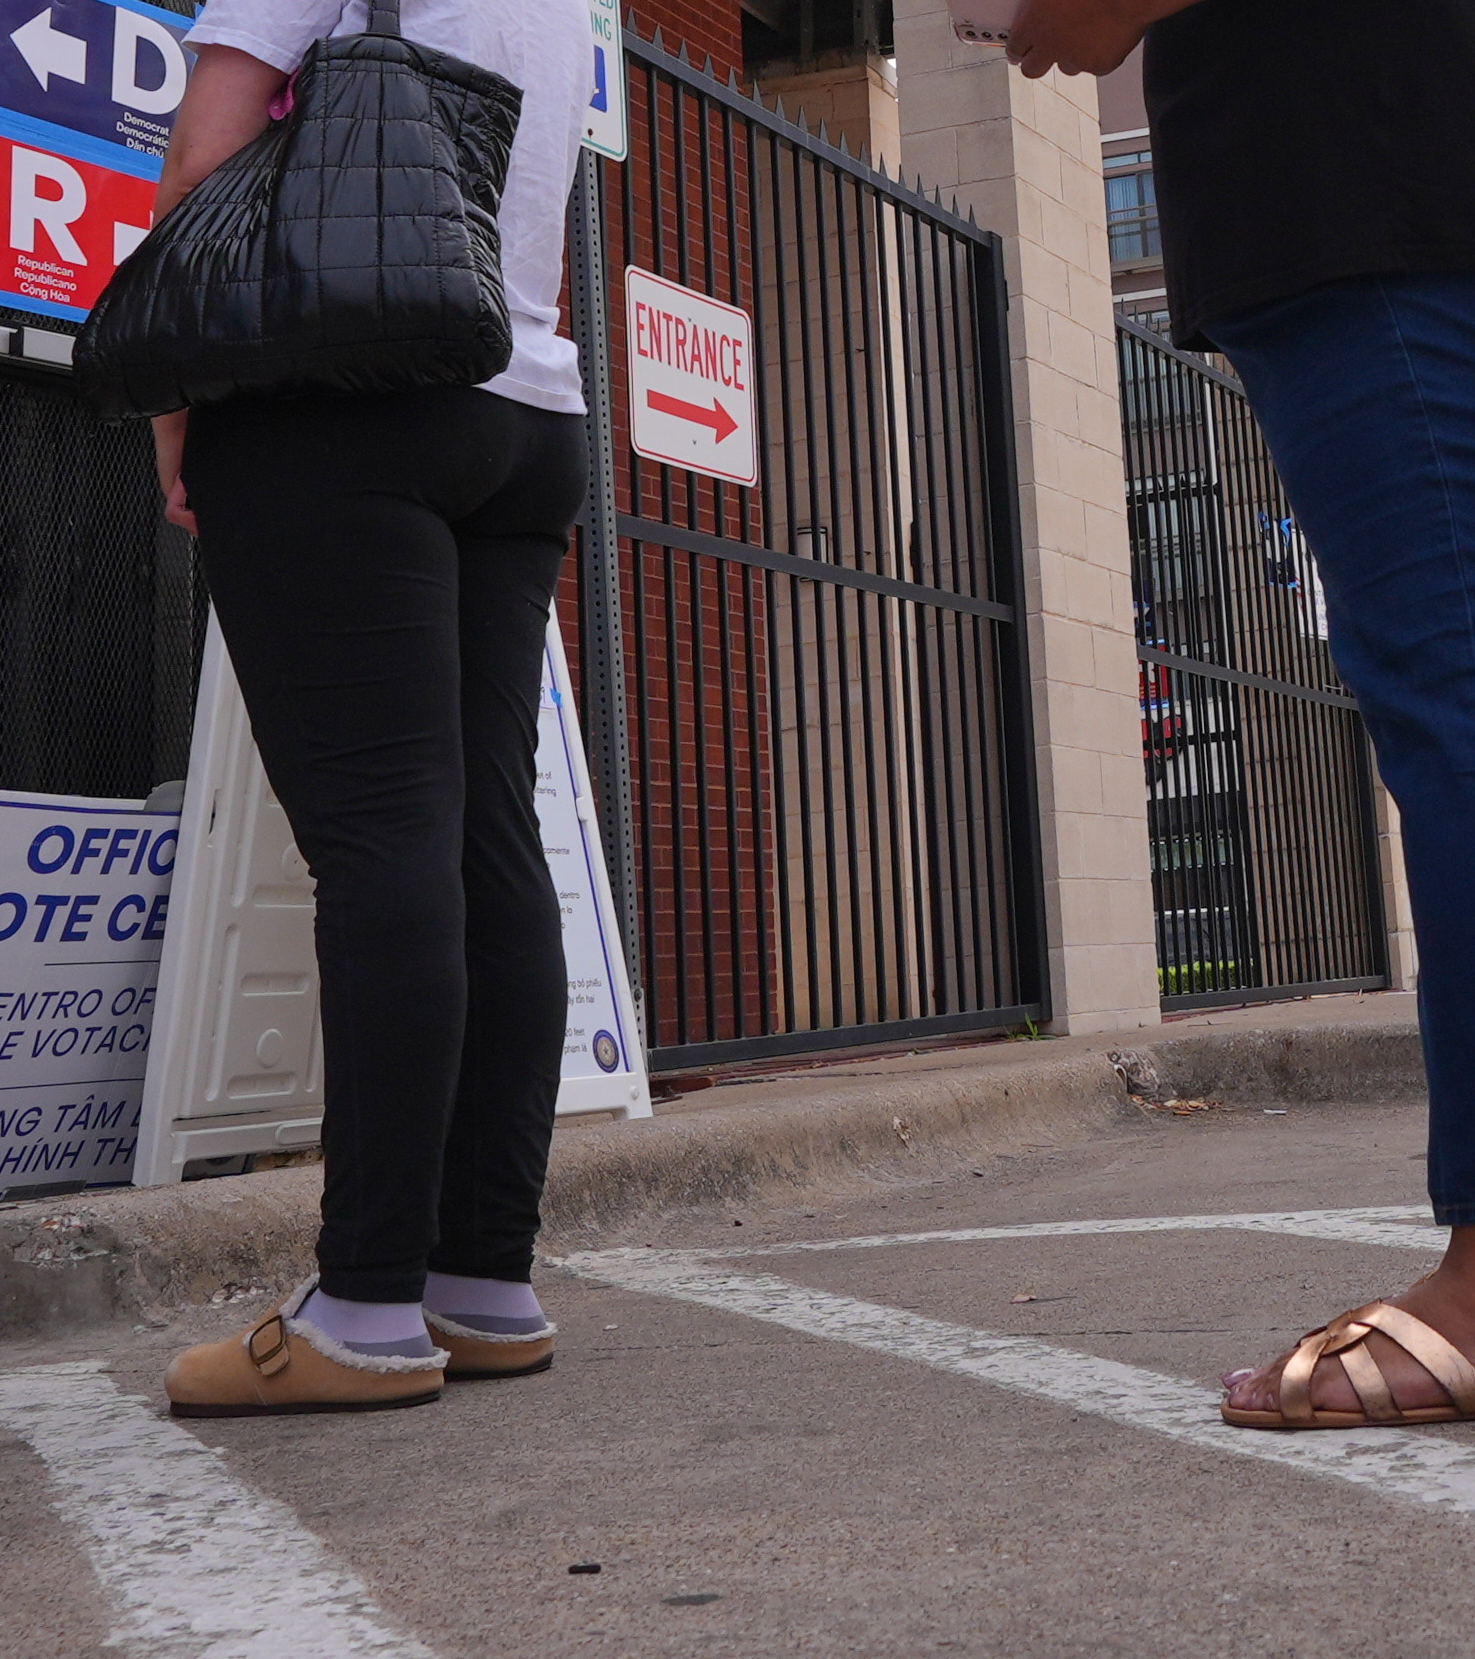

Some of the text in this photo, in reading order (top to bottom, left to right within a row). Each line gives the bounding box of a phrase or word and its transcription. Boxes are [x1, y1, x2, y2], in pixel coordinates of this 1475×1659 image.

[590, 11, 612, 41] ING
[111, 6, 187, 115] D
[116, 121, 170, 148] Democrátic
[123, 111, 170, 137] Democrat
[9, 144, 88, 267] R
[14, 267, 77, 291] Republicano
[18, 255, 74, 277] Republican
[636, 300, 745, 391] ENTRANCE
[27, 825, 179, 876] OFFIC
[107, 894, 170, 941] CE
[111, 987, 156, 1017] OF
[54, 1094, 127, 1132] TÂM
[93, 1137, 138, 1166] TH
